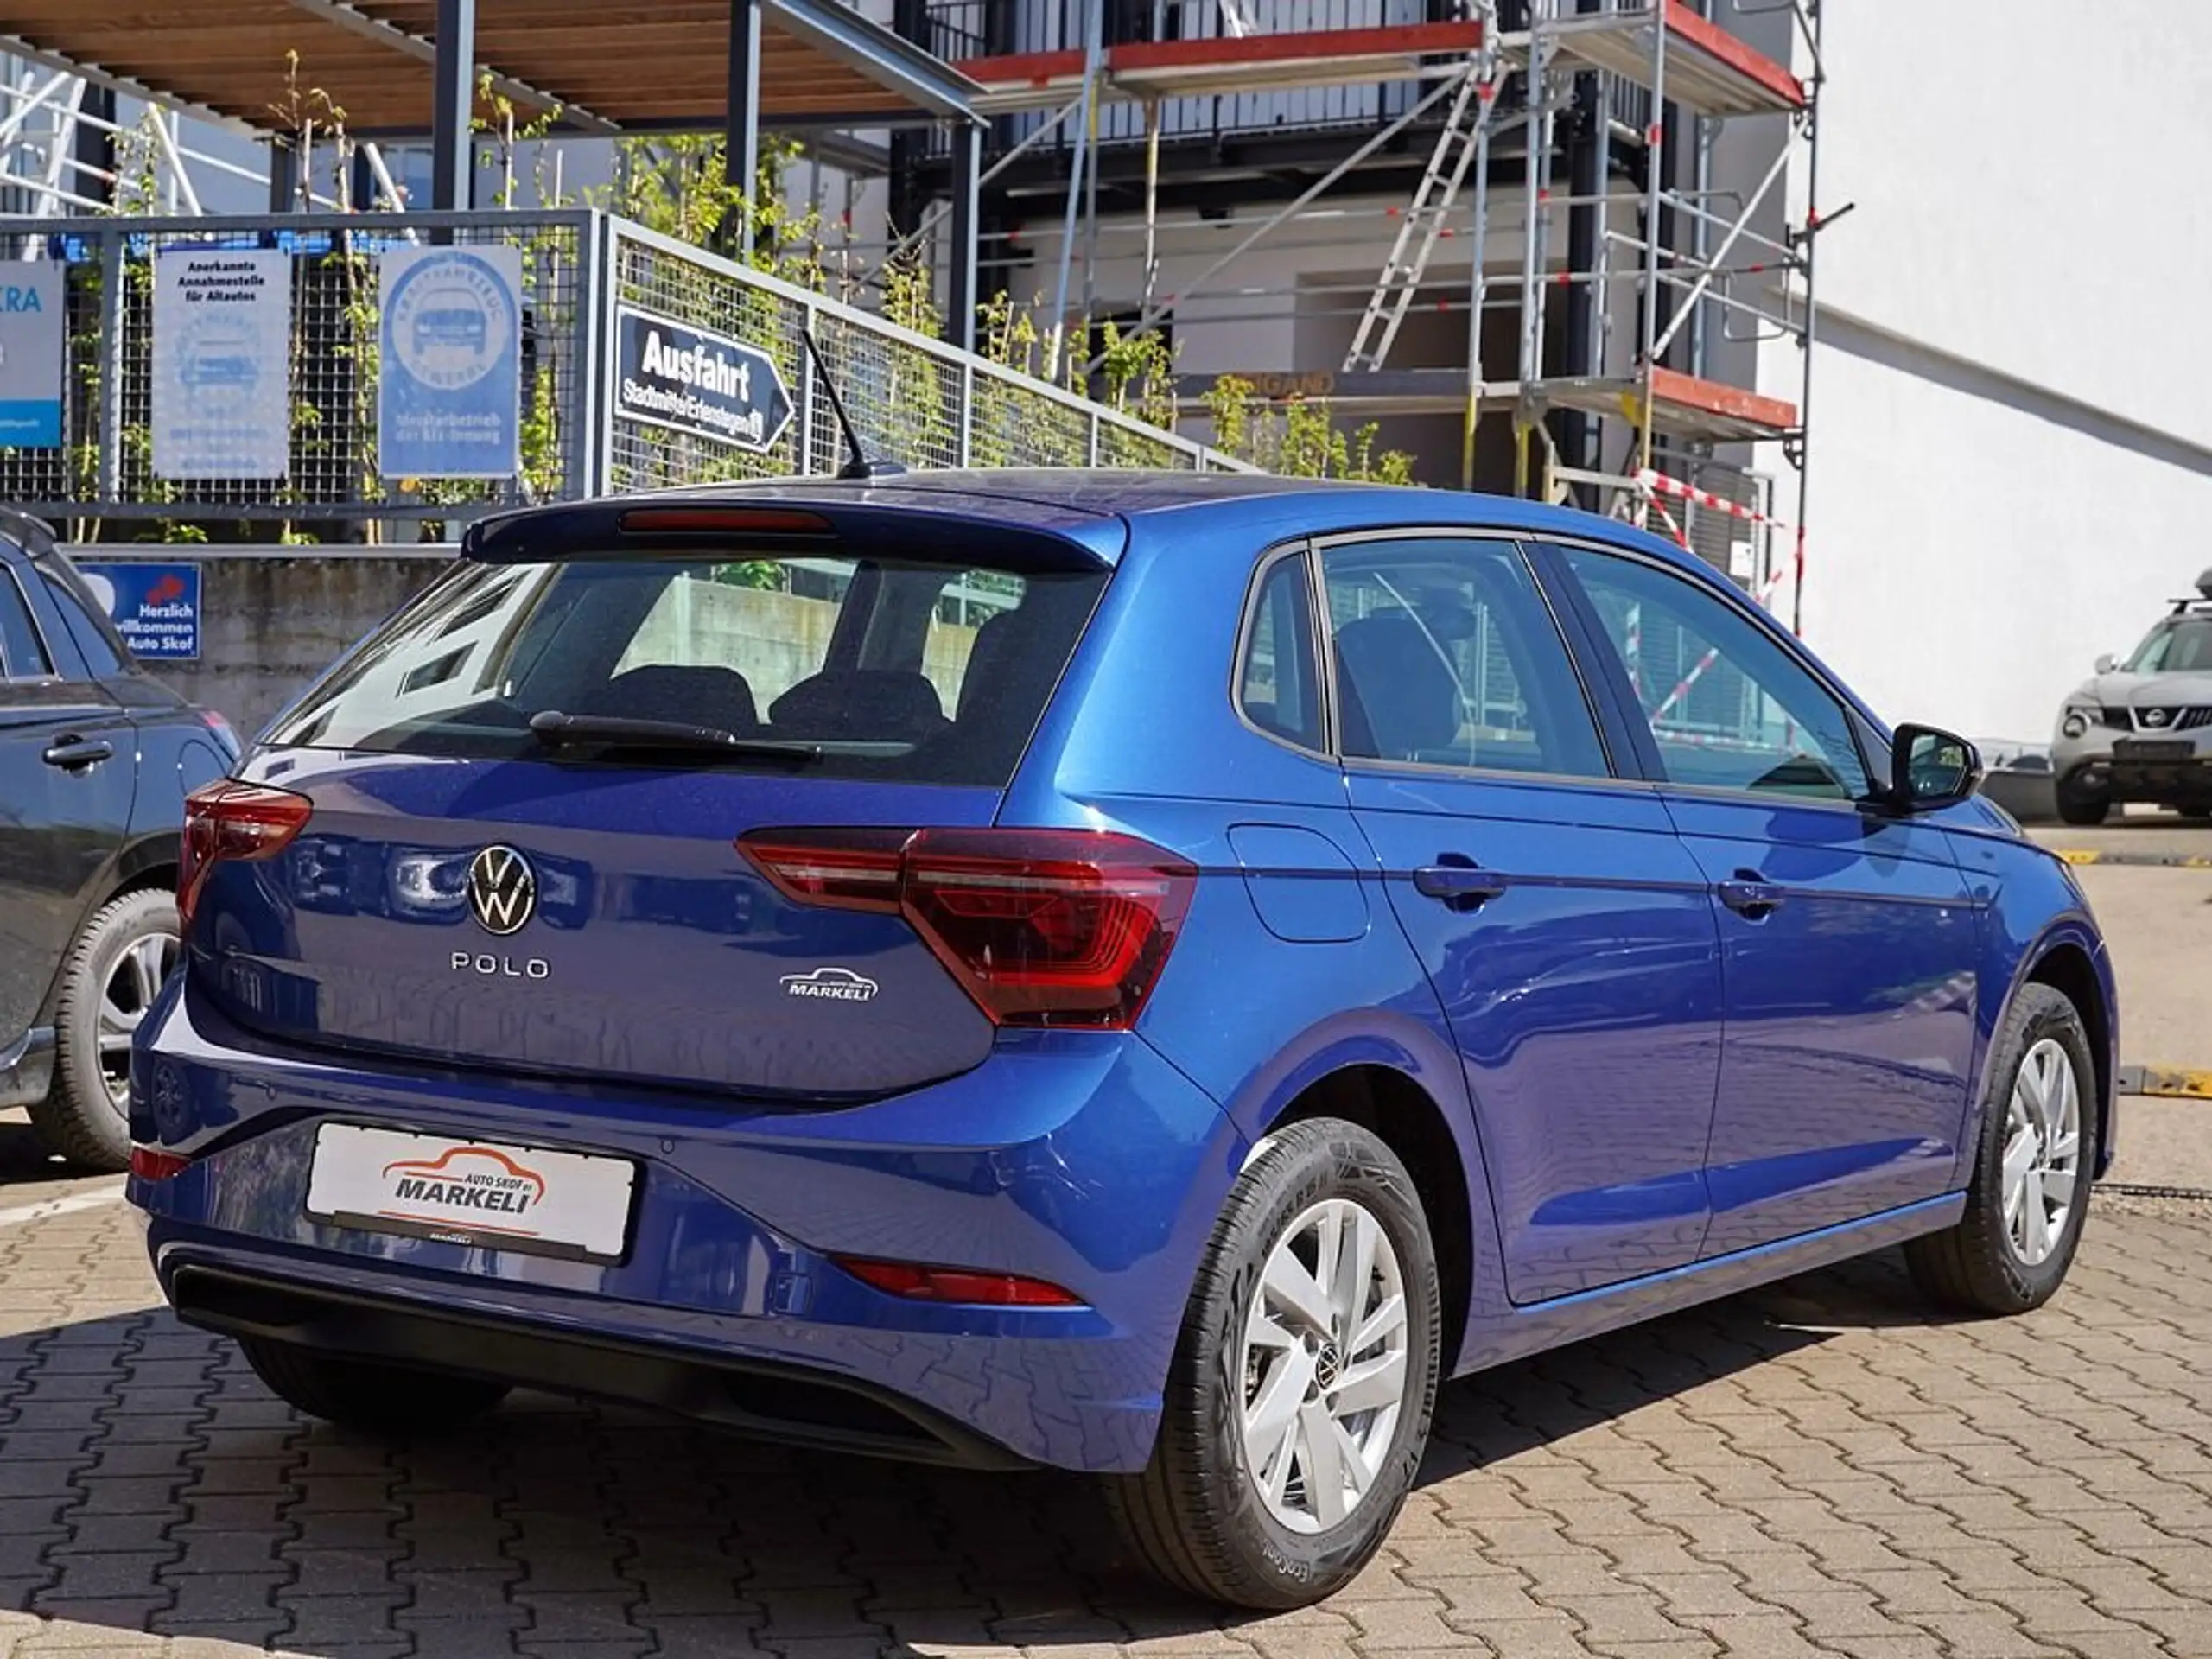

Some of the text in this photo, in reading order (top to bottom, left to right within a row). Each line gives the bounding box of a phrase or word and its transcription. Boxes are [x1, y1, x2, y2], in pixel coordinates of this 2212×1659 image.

[188, 261, 257, 273] Anerkannte
[178, 275, 265, 287] Annahmestelle
[0, 287, 41, 312] RA
[186, 290, 257, 302] für Altautos
[642, 329, 750, 403] Ausfahrt
[140, 603, 193, 618] Herzlich
[128, 636, 193, 650] Auto Skof
[450, 951, 549, 979] POLO
[788, 983, 870, 1001] MARKELI
[464, 1173, 493, 1187] AUTO
[395, 1177, 531, 1214] MARKELI
